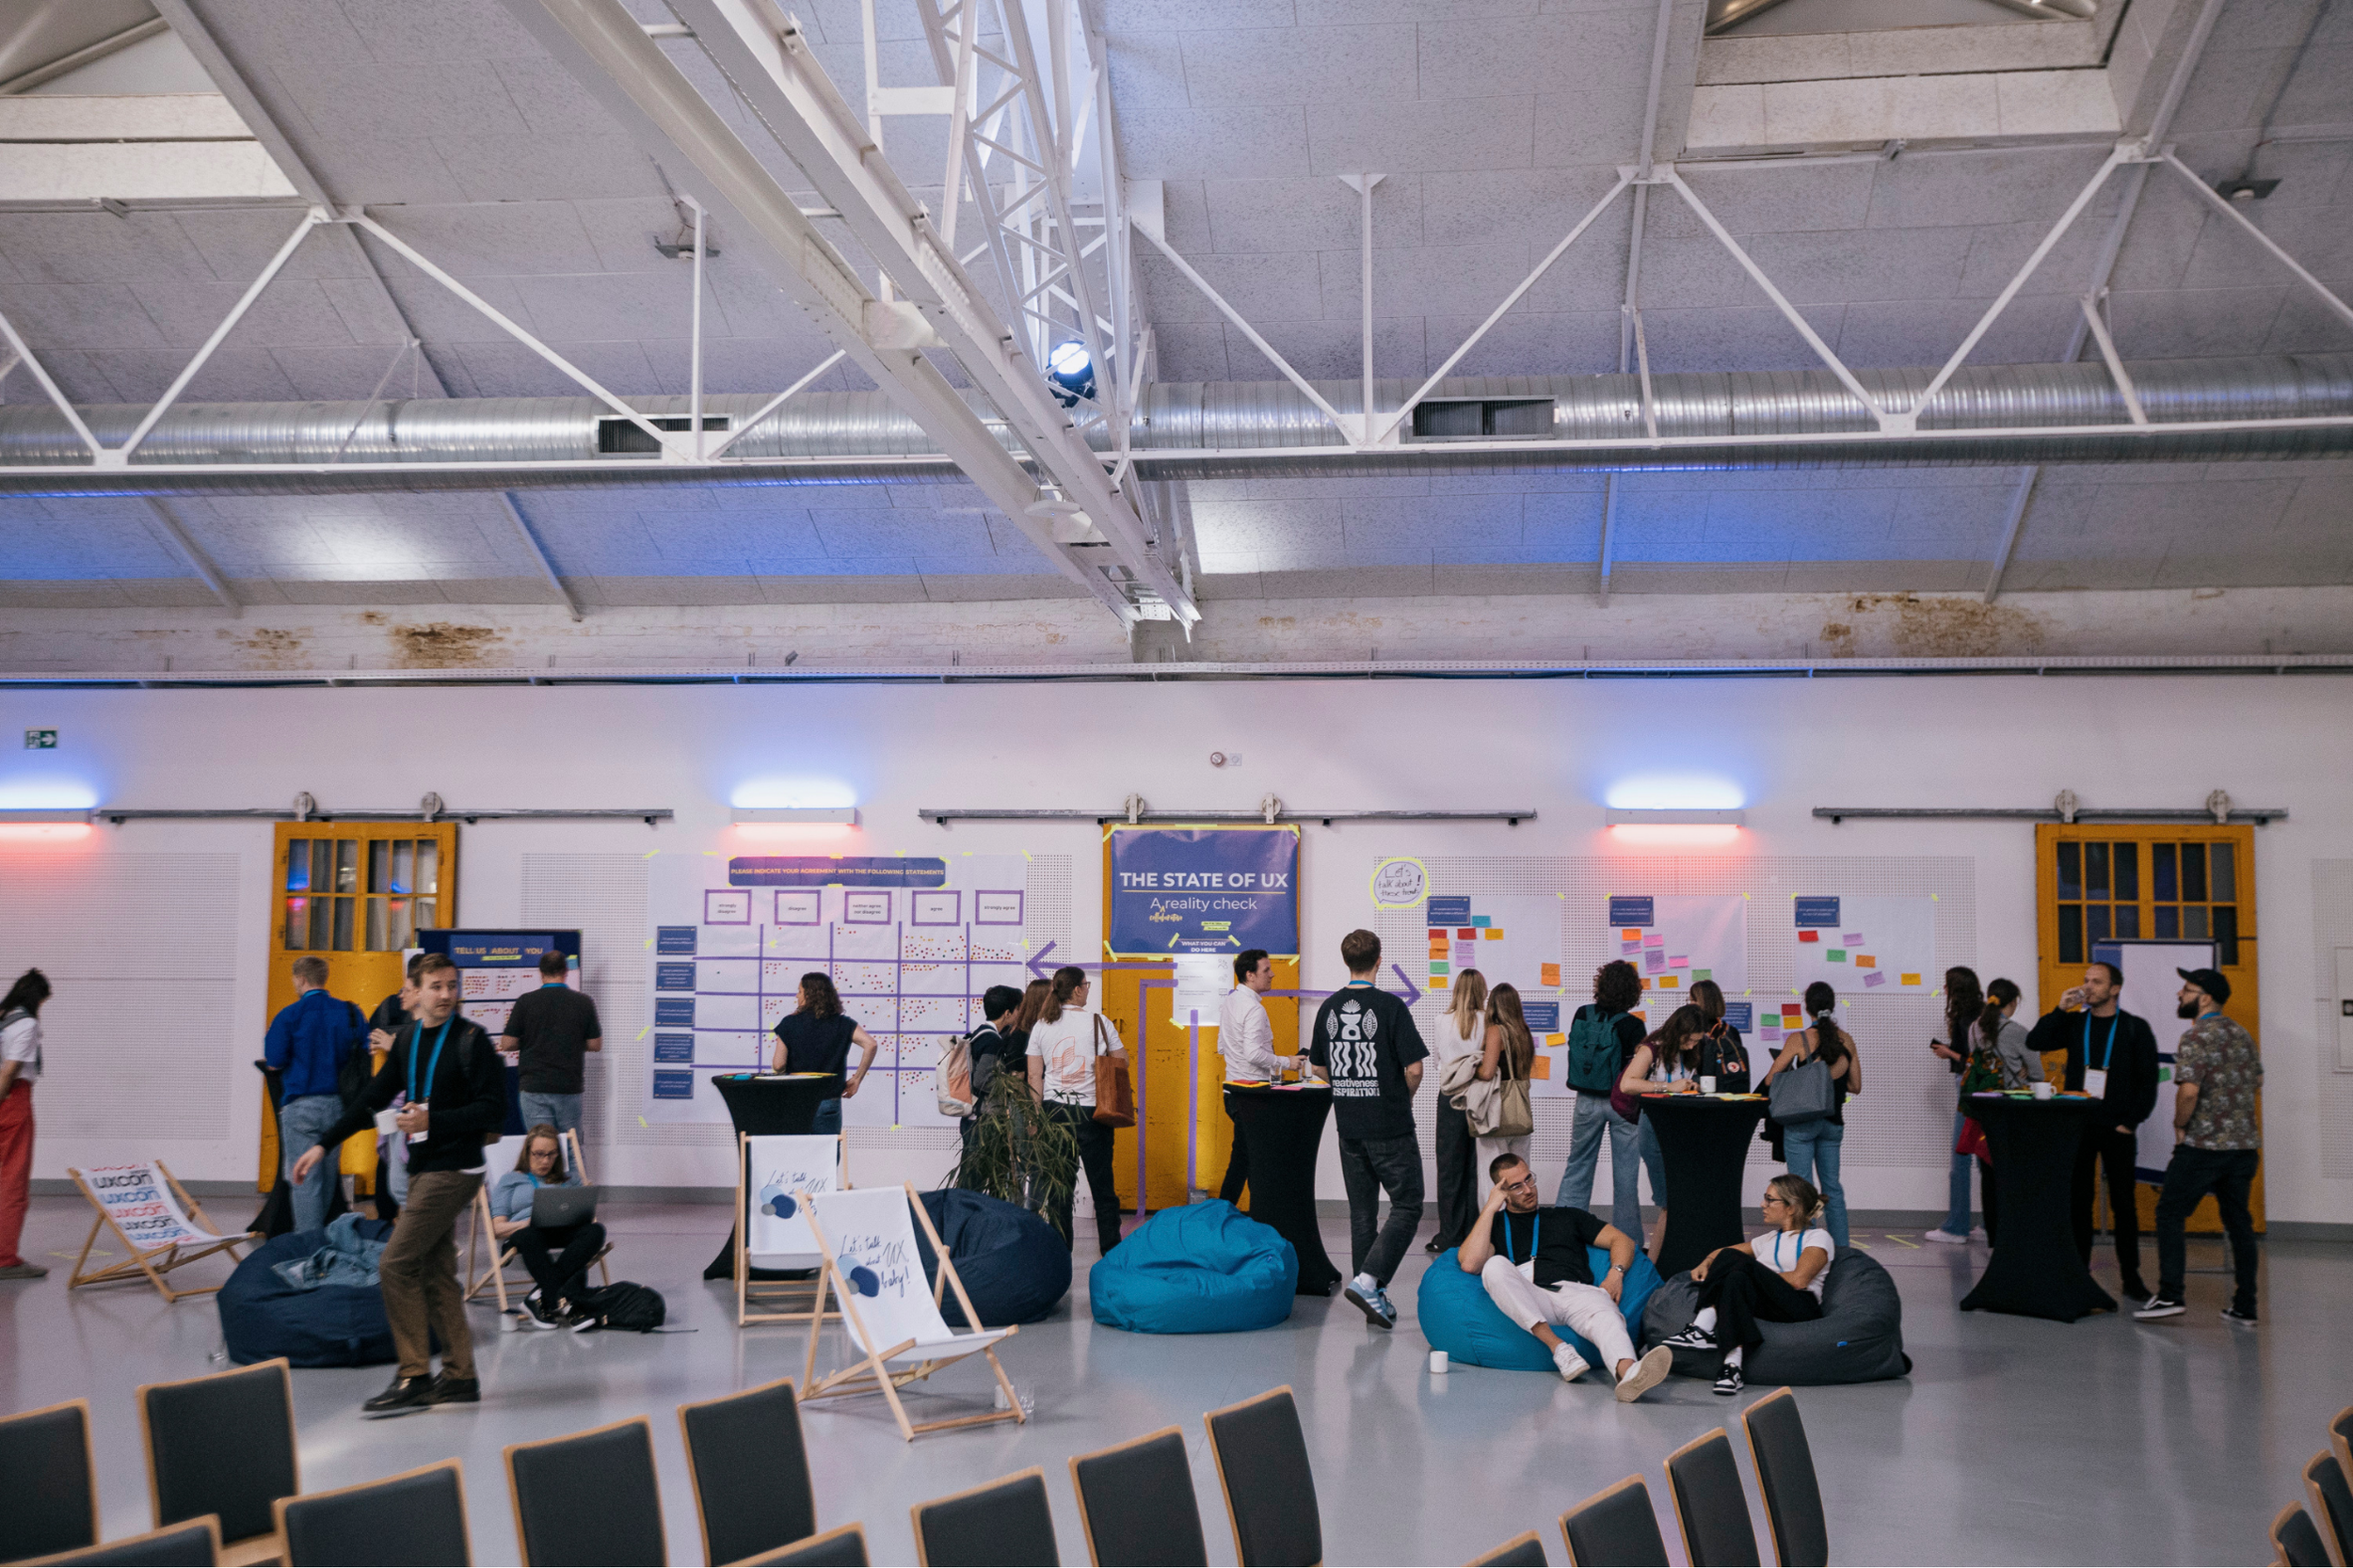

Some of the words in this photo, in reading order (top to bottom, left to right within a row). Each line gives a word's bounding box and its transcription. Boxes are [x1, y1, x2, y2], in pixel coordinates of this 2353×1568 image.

[1385, 864, 1412, 878] Let's
[1120, 872, 1158, 887] THE
[1163, 872, 1224, 887] STATE
[1228, 872, 1256, 888] OF
[1261, 872, 1289, 888] UX
[1378, 879, 1394, 888] talk
[1395, 878, 1413, 888] about
[1150, 897, 1161, 909] A
[1165, 897, 1209, 912] reality
[1213, 897, 1257, 910] check
[1332, 1078, 1379, 1087] reativeness
[92, 1174, 153, 1189] uxcon
[99, 1190, 161, 1204] uxcon
[839, 1234, 860, 1258] Let's
[865, 1235, 882, 1250] talk
[866, 1254, 881, 1266] about
[881, 1265, 910, 1298] baby!
